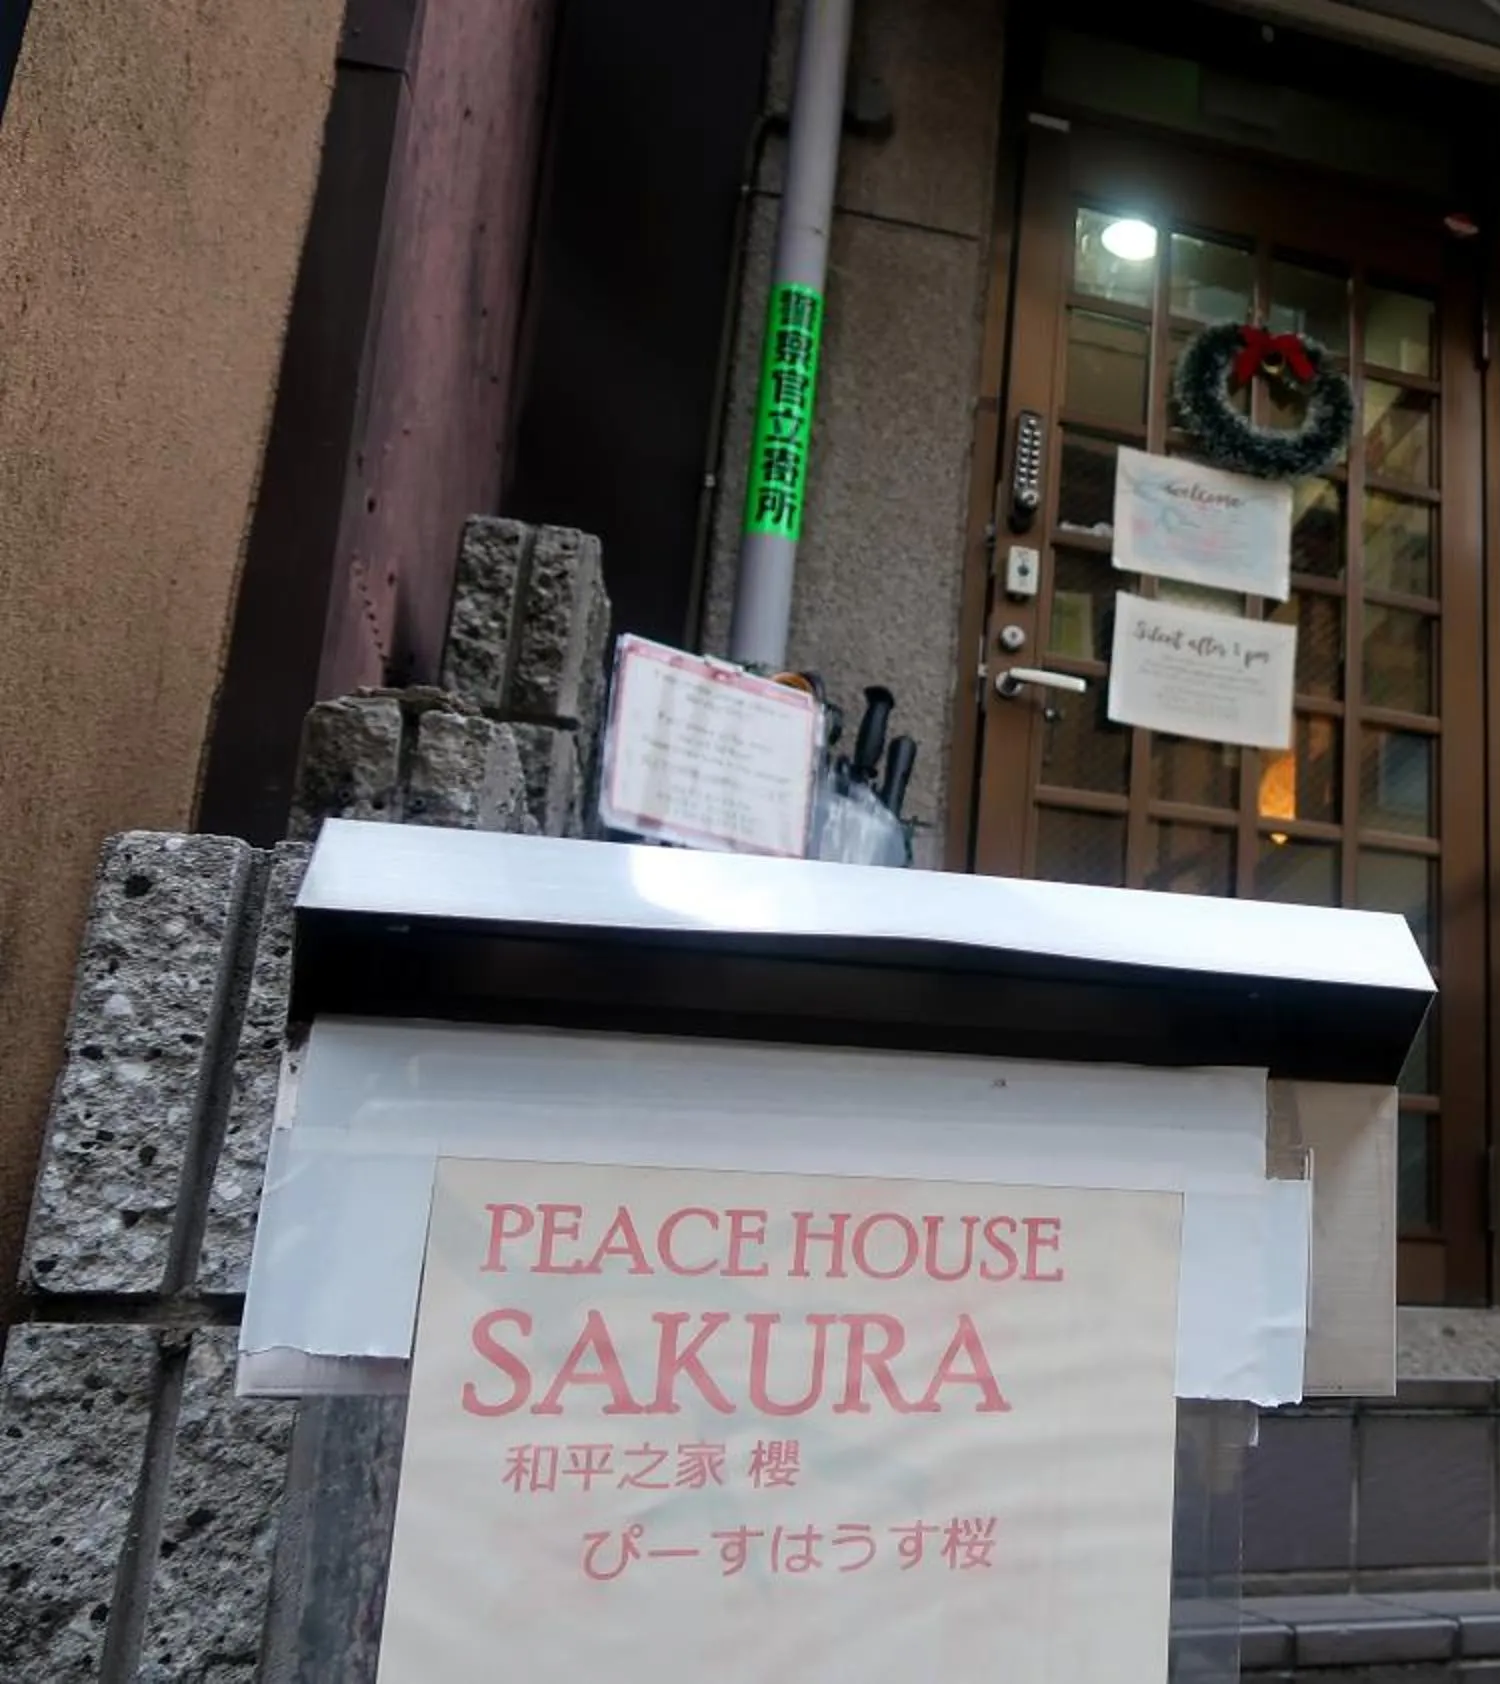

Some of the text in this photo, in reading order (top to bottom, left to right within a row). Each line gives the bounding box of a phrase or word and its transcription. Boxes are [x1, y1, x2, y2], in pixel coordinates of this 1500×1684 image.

[1187, 635, 1227, 659] after
[480, 1203, 1066, 1285] PEACE HOUSE
[461, 1308, 1012, 1418] SAKURA
[502, 1440, 801, 1494] 和平之家 櫻
[582, 1517, 1000, 1583] ぴーすはうす桜
